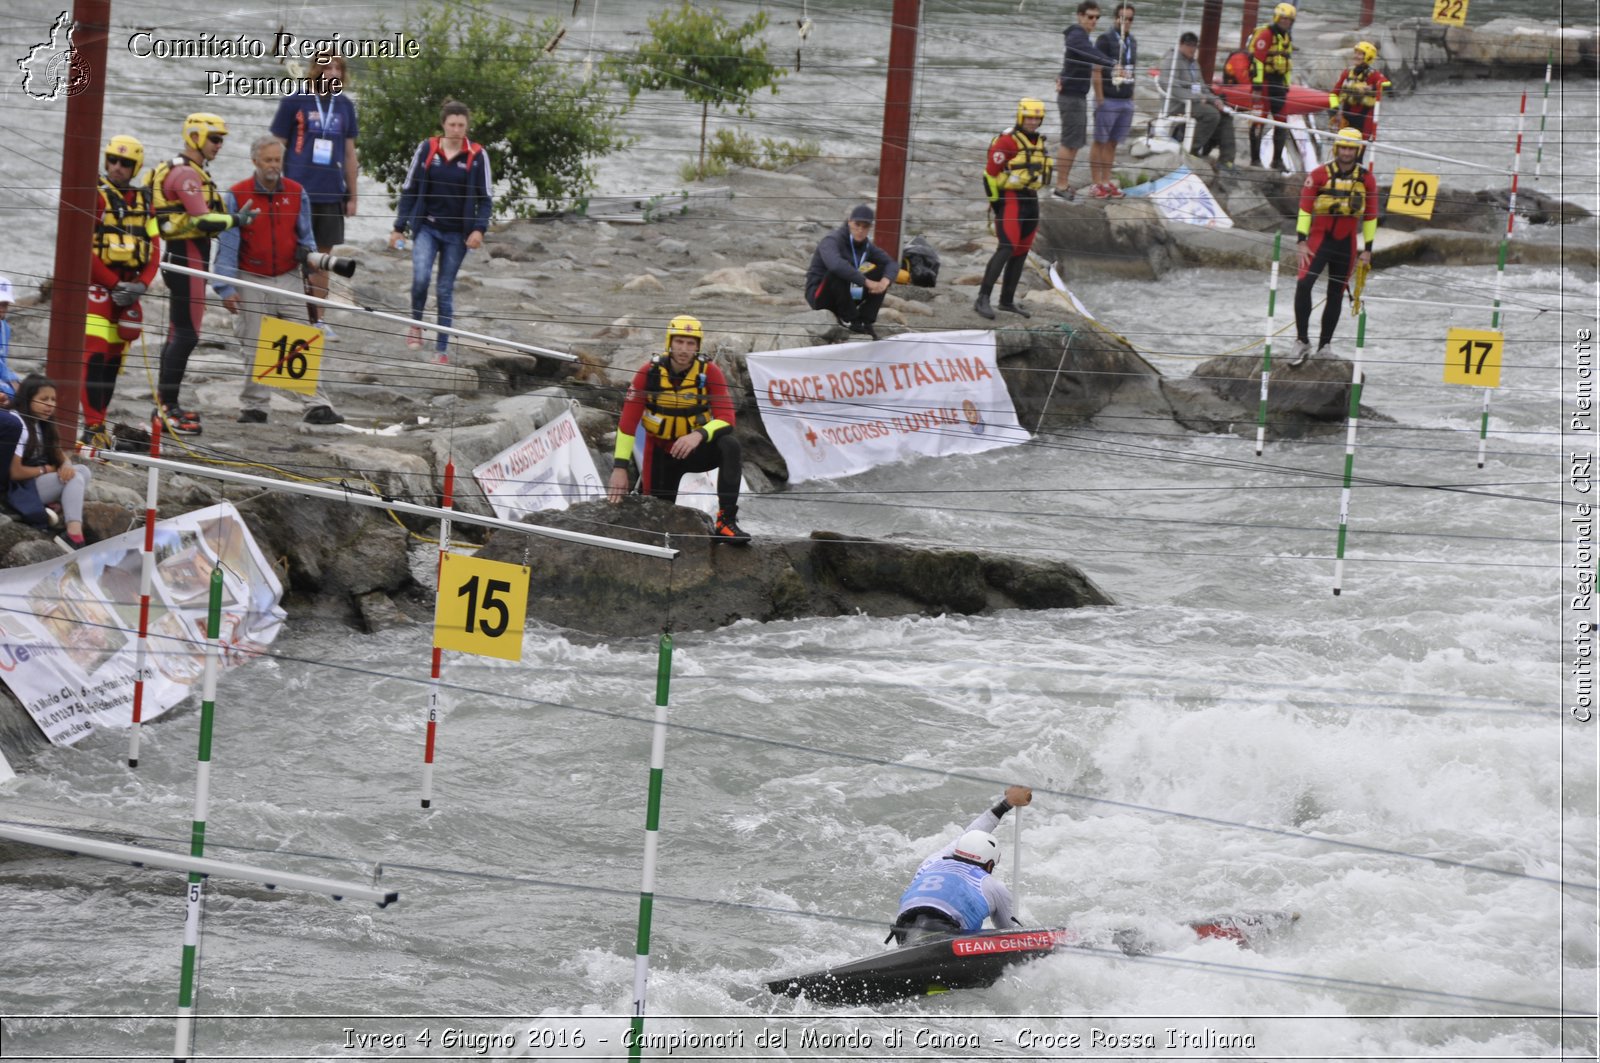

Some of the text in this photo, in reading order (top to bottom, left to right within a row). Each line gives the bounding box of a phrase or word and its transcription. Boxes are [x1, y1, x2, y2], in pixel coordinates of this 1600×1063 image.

[1438, 0, 1463, 19] 22
[1402, 178, 1428, 207] 19
[272, 334, 310, 379] 16
[1459, 340, 1493, 375] 17
[767, 356, 992, 407] CROCE ROSSA ITALIANA
[822, 407, 960, 445] SOCCORSO FLUVIALE
[457, 575, 511, 638] 15
[917, 875, 945, 891] 8
[957, 940, 996, 953] TEAM
